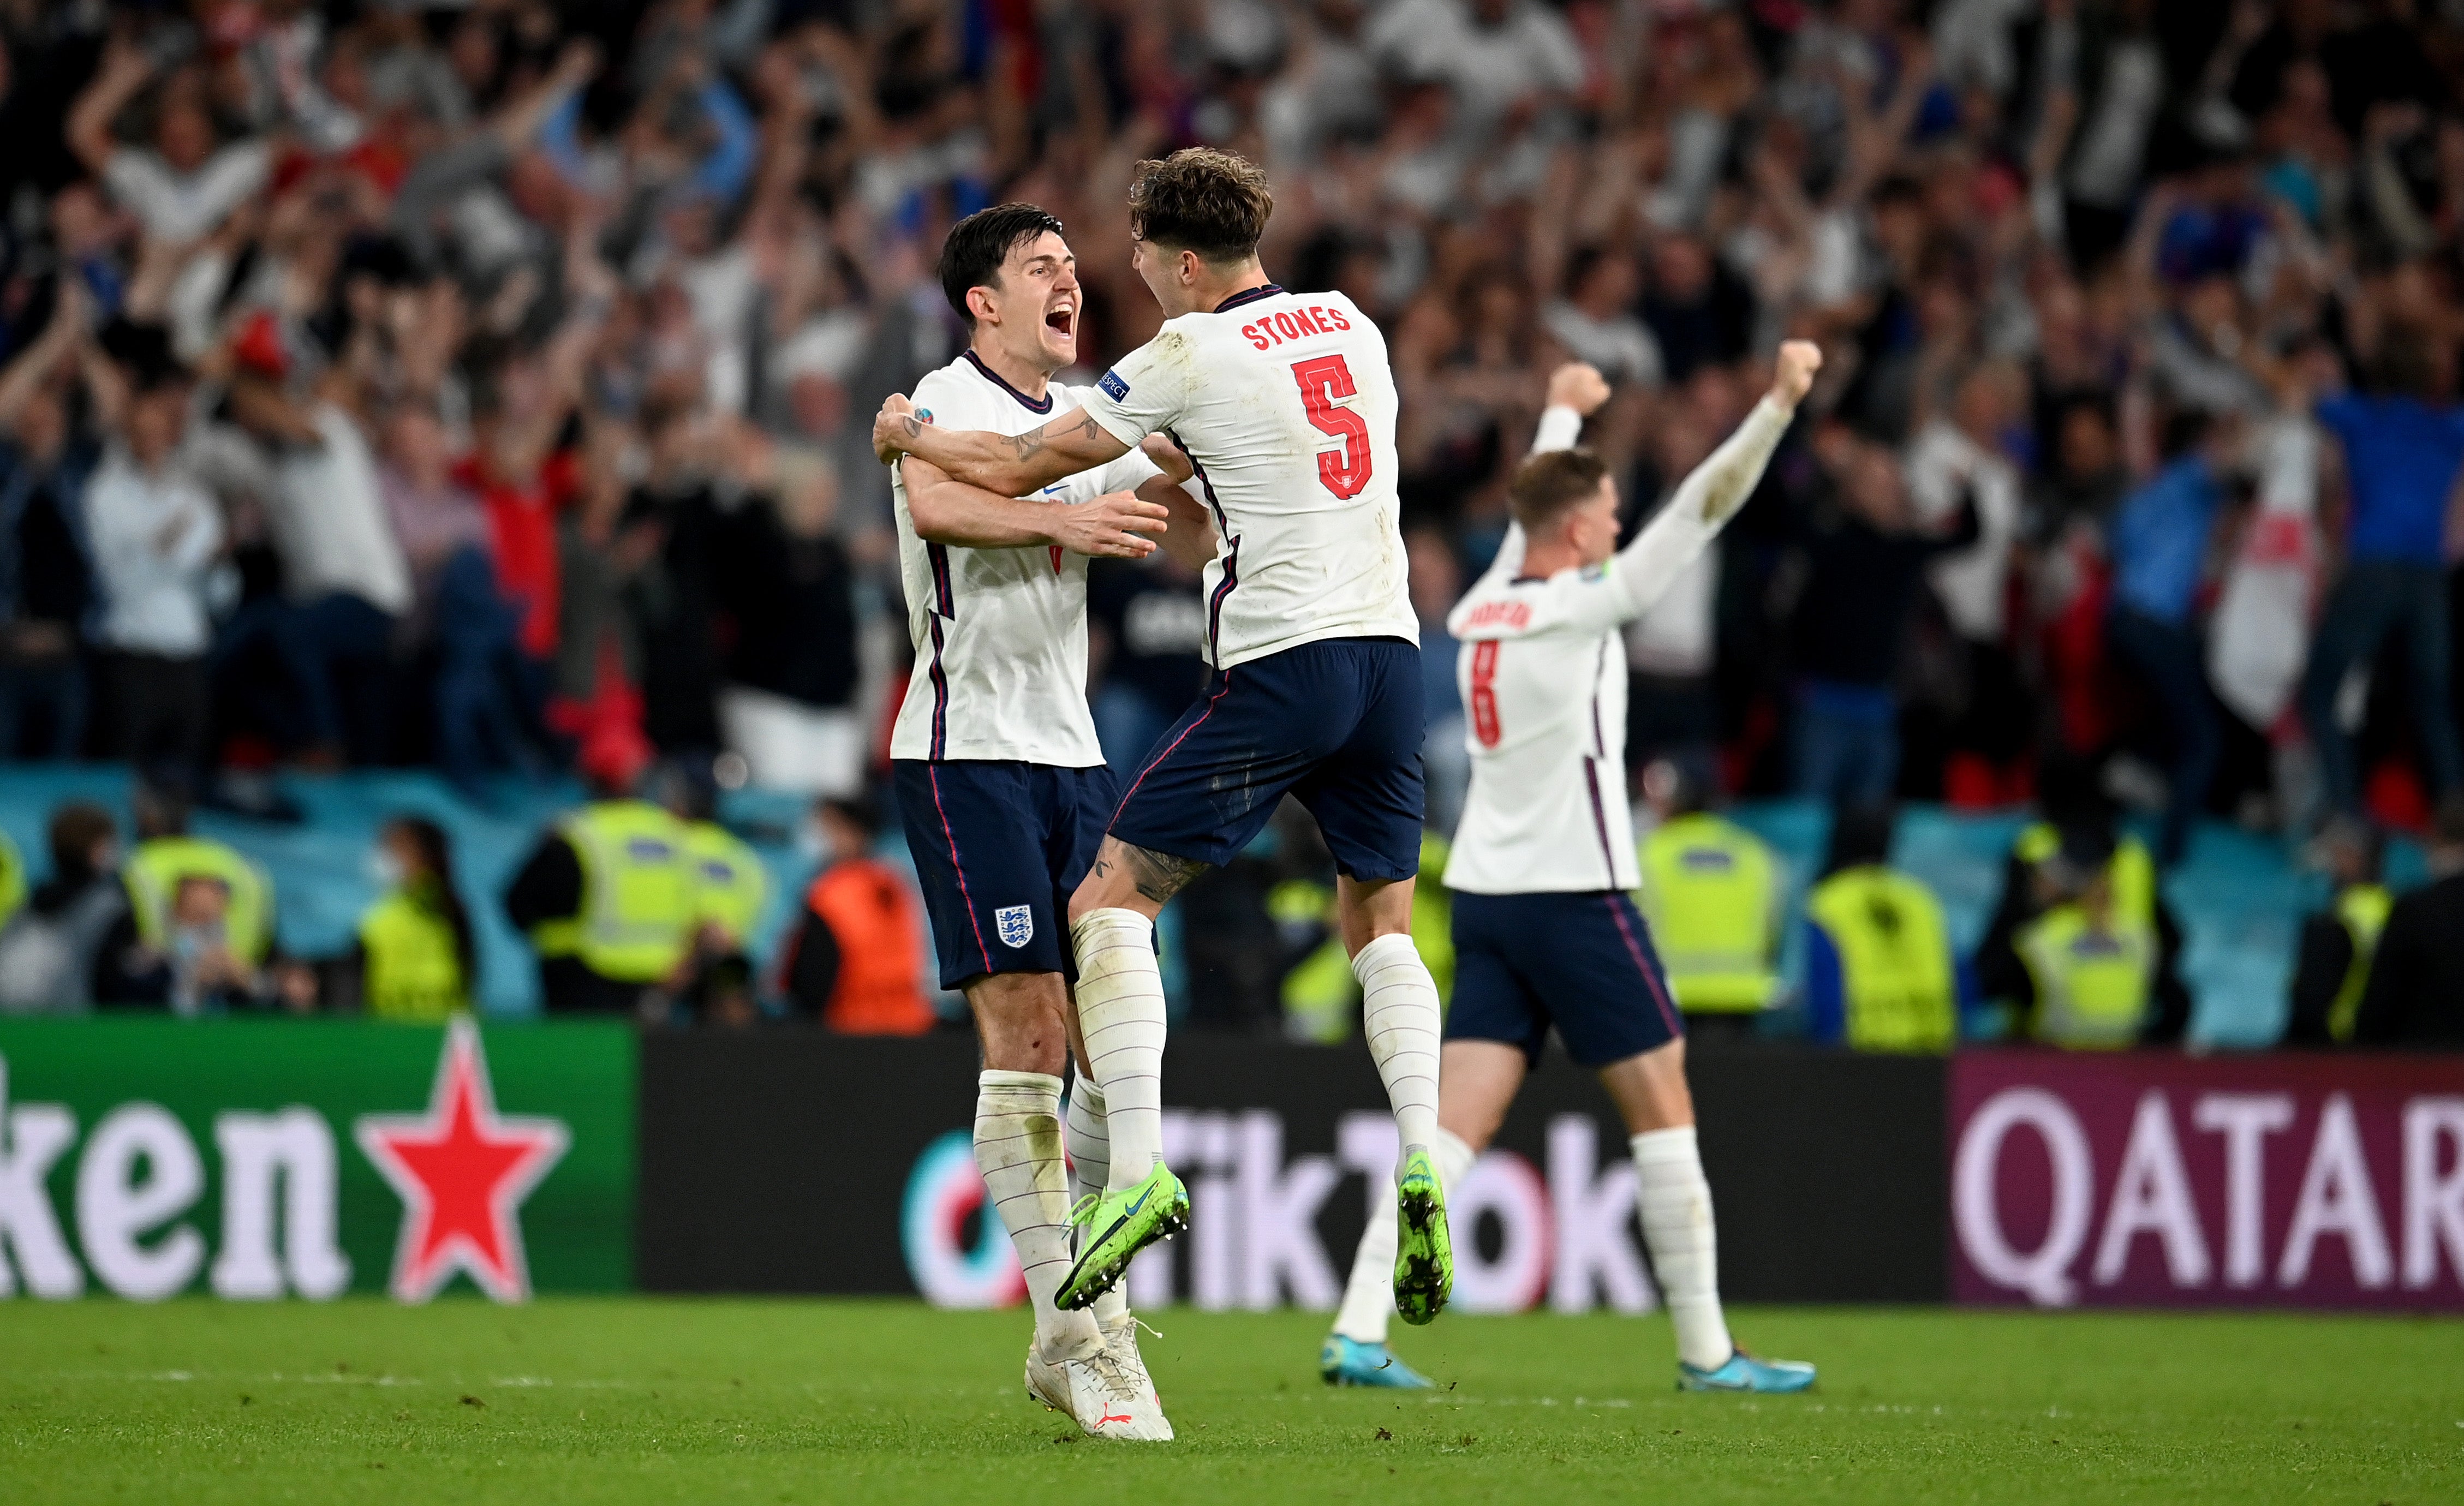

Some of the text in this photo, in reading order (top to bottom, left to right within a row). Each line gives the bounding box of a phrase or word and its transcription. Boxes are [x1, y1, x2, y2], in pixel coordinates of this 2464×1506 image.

[1101, 373, 1126, 397] ESPECT
[1242, 306, 1351, 351] STONES
[1290, 354, 1373, 500] 5
[1470, 640, 1501, 749] 8
[0, 1050, 353, 1302] ken
[1952, 1086, 2464, 1306] QATAR
